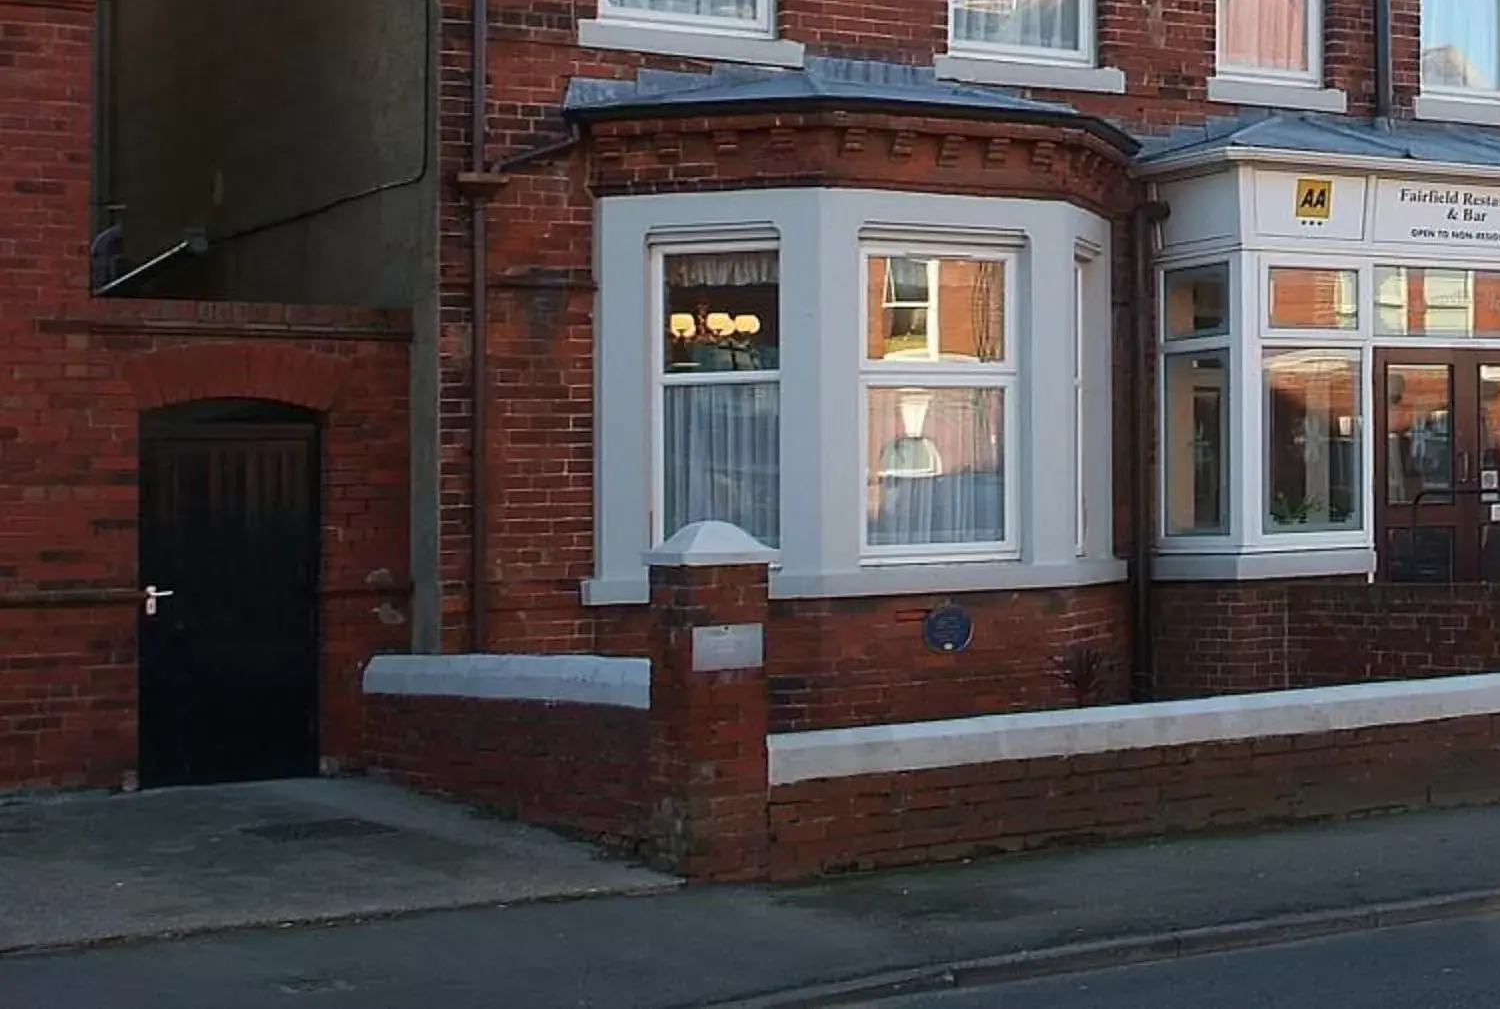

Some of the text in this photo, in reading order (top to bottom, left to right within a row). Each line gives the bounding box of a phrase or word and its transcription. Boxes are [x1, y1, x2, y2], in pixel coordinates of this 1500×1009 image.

[1300, 188, 1326, 208] AA
[1400, 188, 1459, 205] Fairfield
[1447, 207, 1488, 222] & Bar
[1411, 228, 1435, 238] OPEN
[1438, 230, 1449, 238] TO
